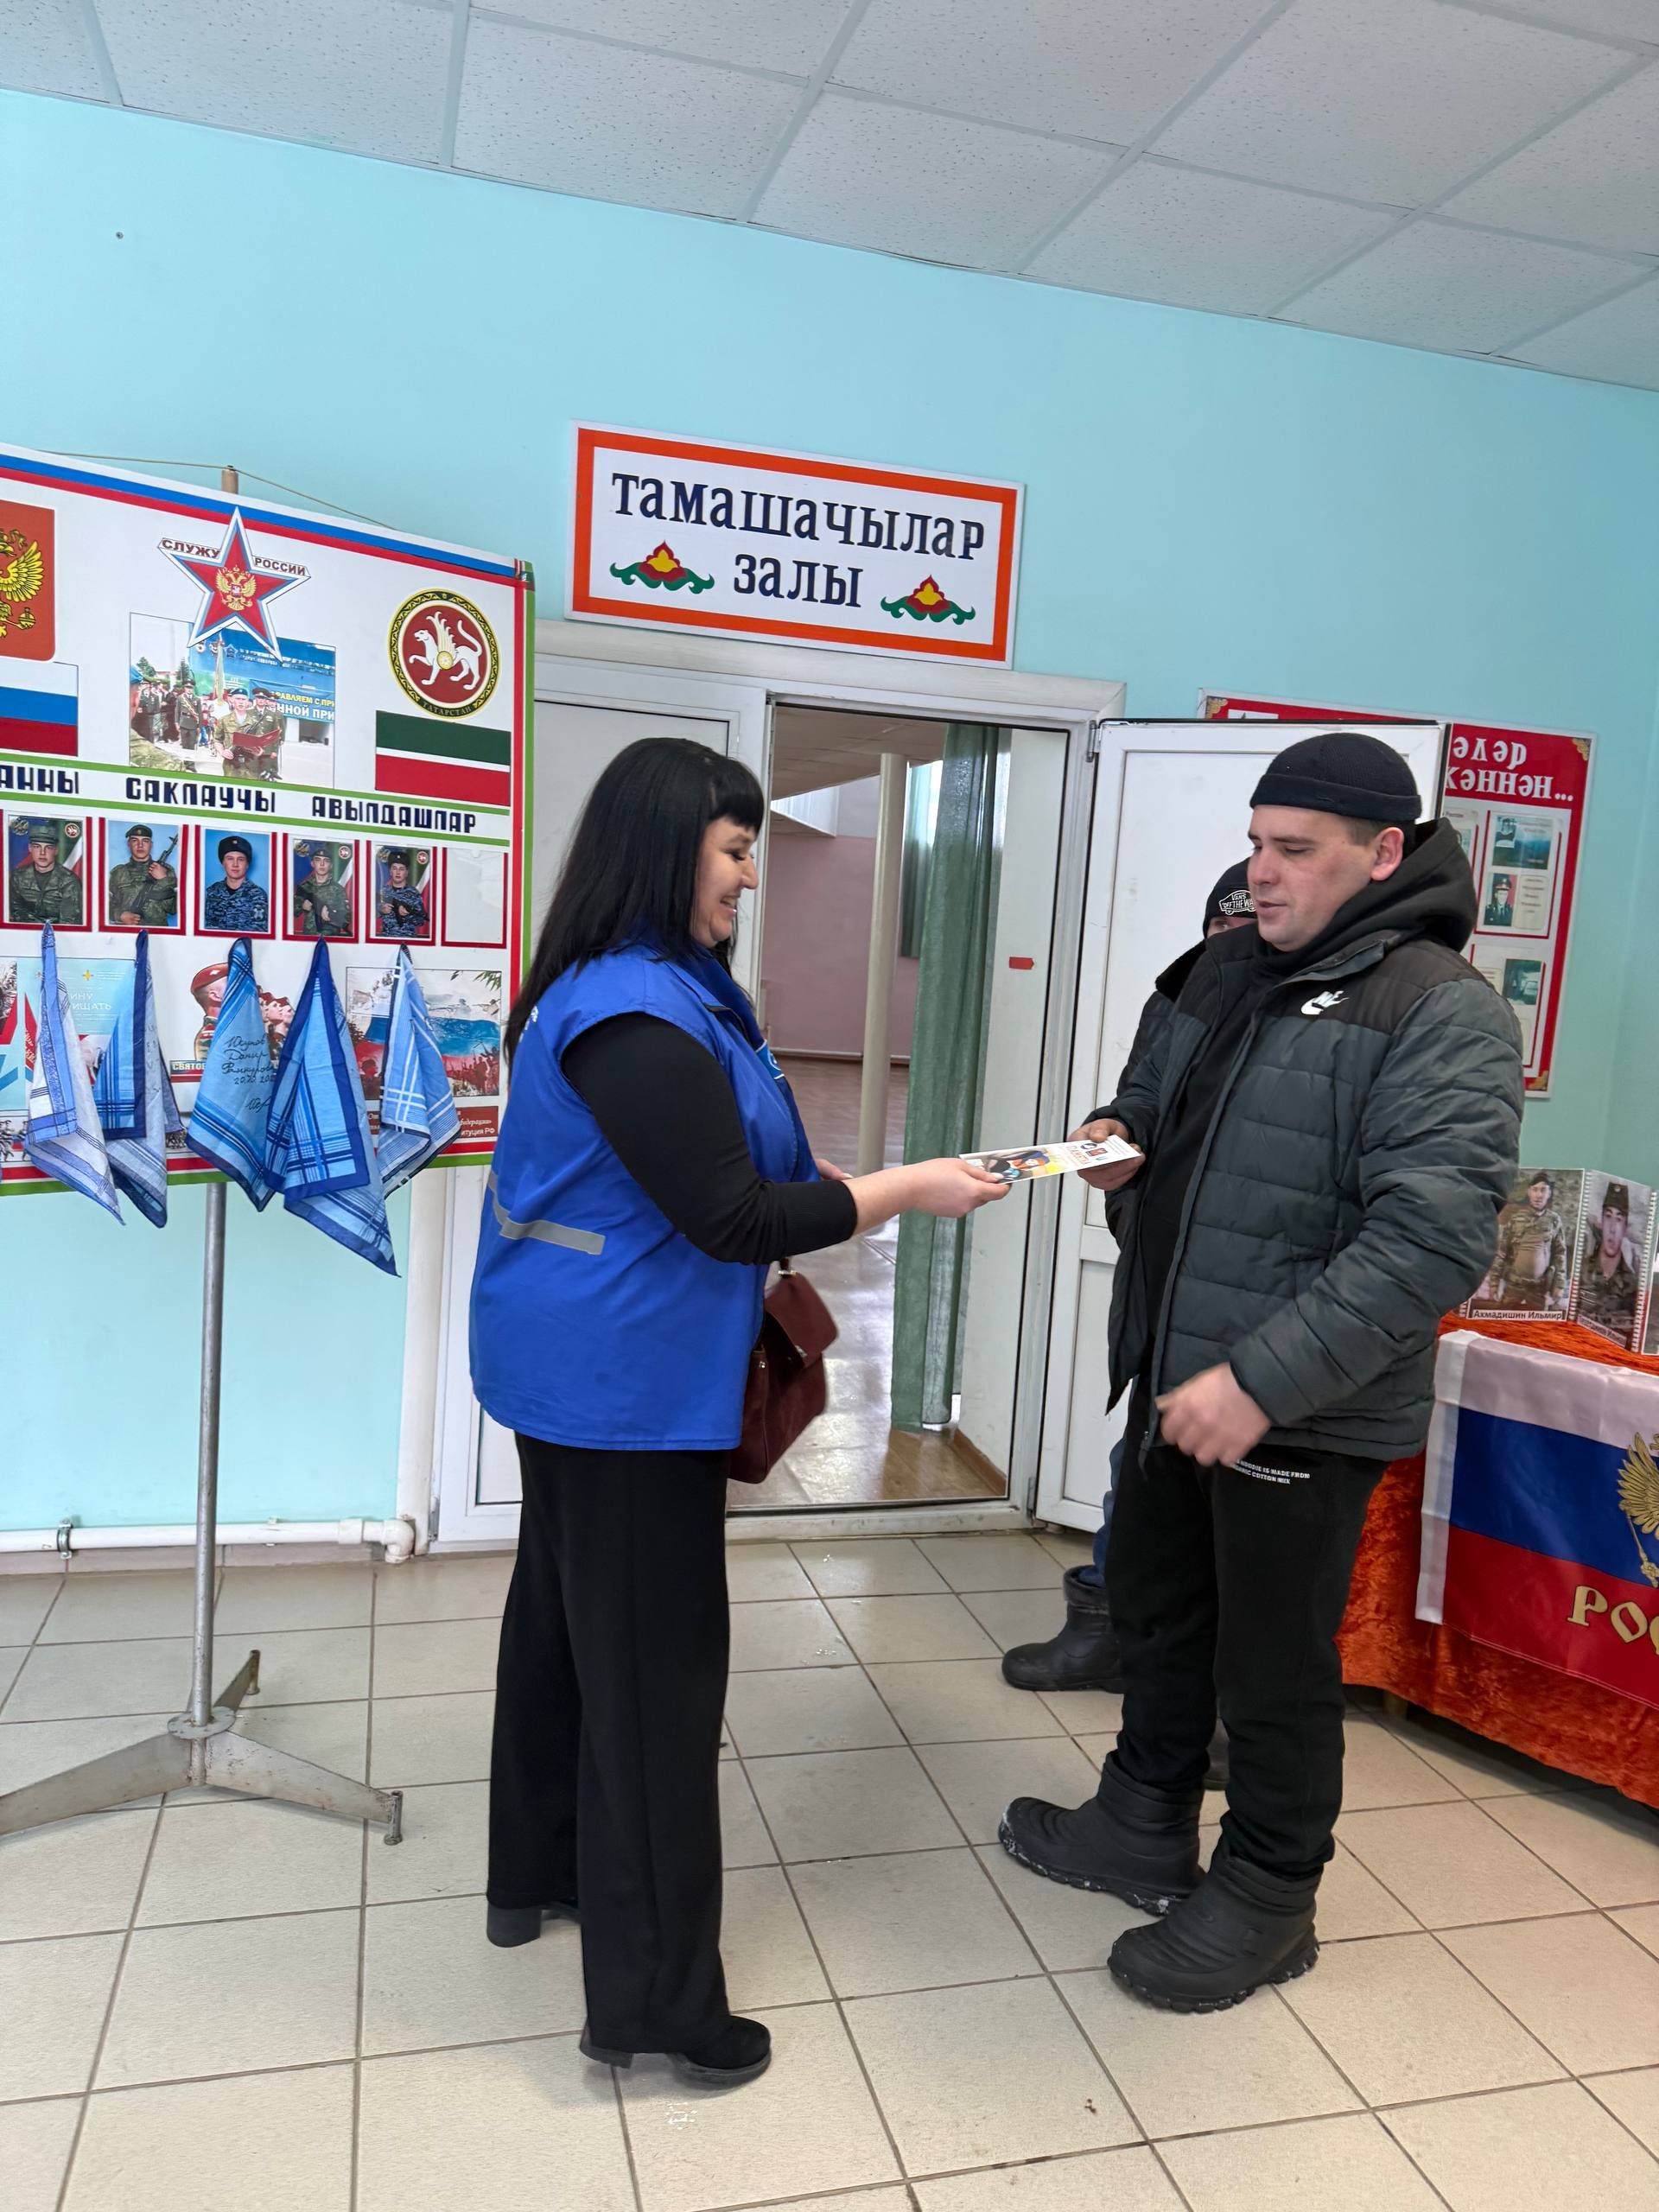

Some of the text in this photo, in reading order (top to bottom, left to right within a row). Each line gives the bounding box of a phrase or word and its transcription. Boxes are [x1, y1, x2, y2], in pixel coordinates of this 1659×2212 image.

[162, 539, 306, 576] СЛУЖУ РОССИИ
[423, 702, 472, 716] ТАТАРСТАН
[126, 777, 276, 813] САКЛАУЧЫ
[312, 796, 476, 834] АВЫЛДАШЛАР
[1473, 1311, 1563, 1320] Ахмадишин Ильмир
[1270, 1468, 1290, 1477] MADE
[1567, 1586, 1659, 1656] РО
